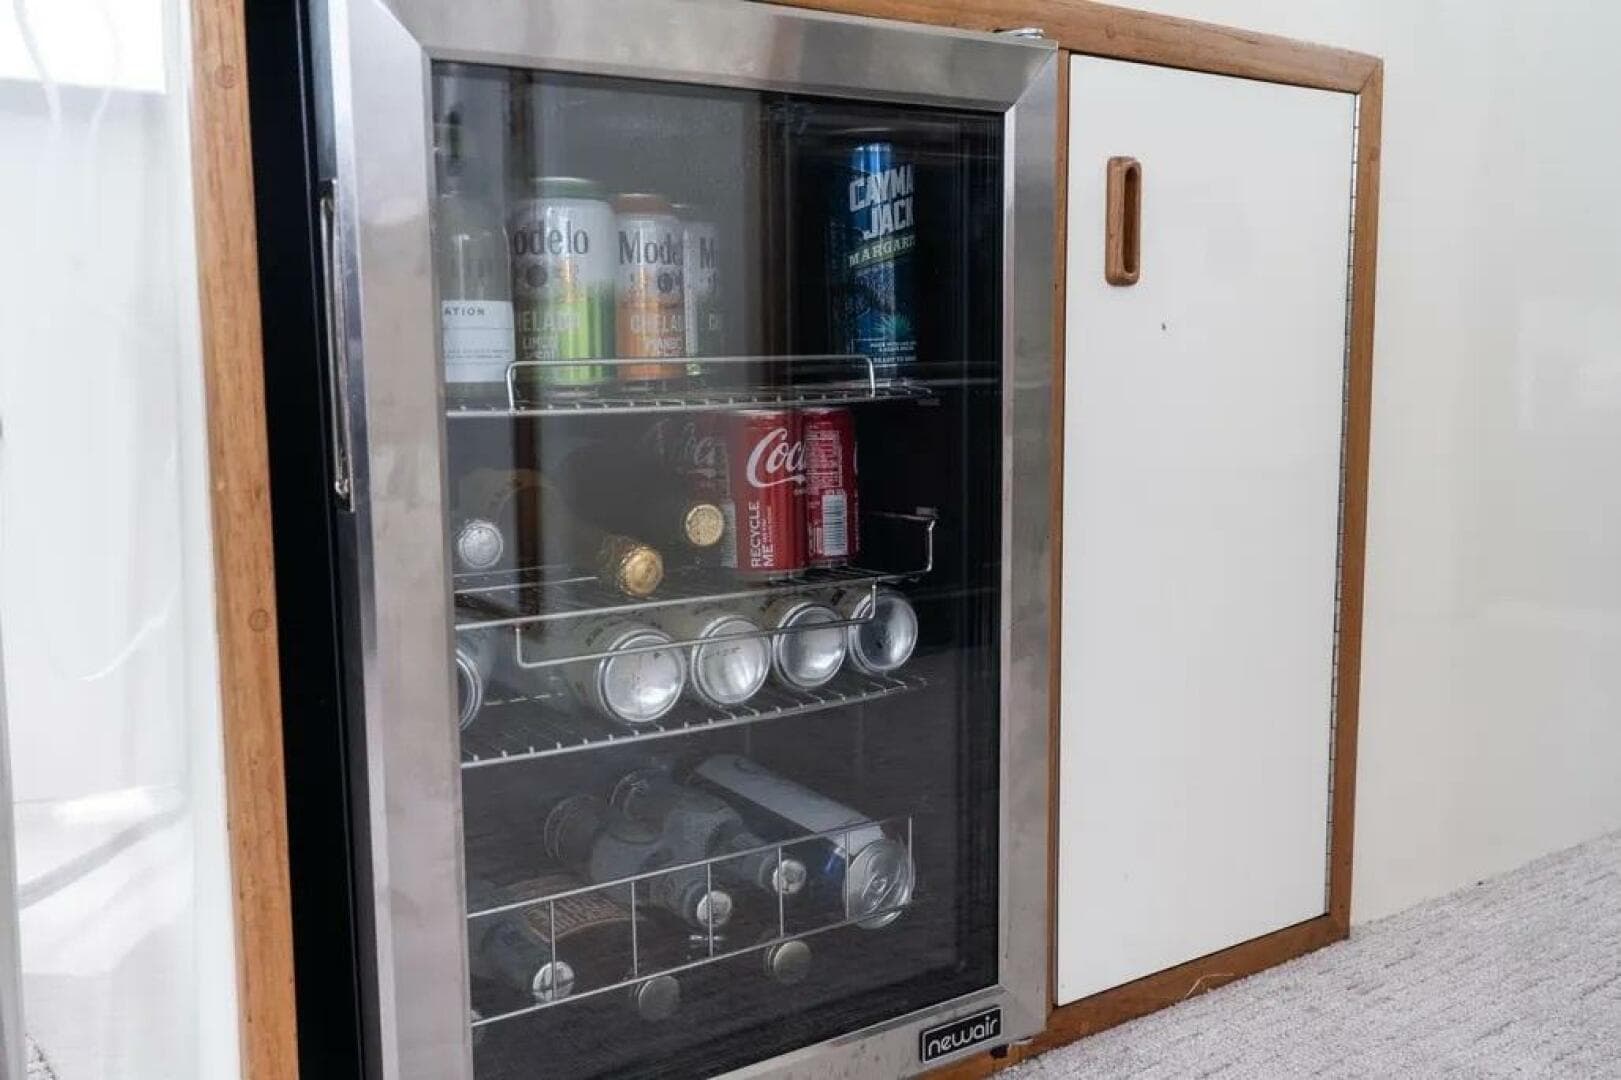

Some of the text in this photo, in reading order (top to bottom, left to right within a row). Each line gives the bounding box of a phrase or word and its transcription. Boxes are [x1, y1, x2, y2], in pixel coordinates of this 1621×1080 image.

[749, 500, 762, 567] RECYCLE
[761, 543, 775, 567] ME
[928, 1016, 998, 1057] newair
